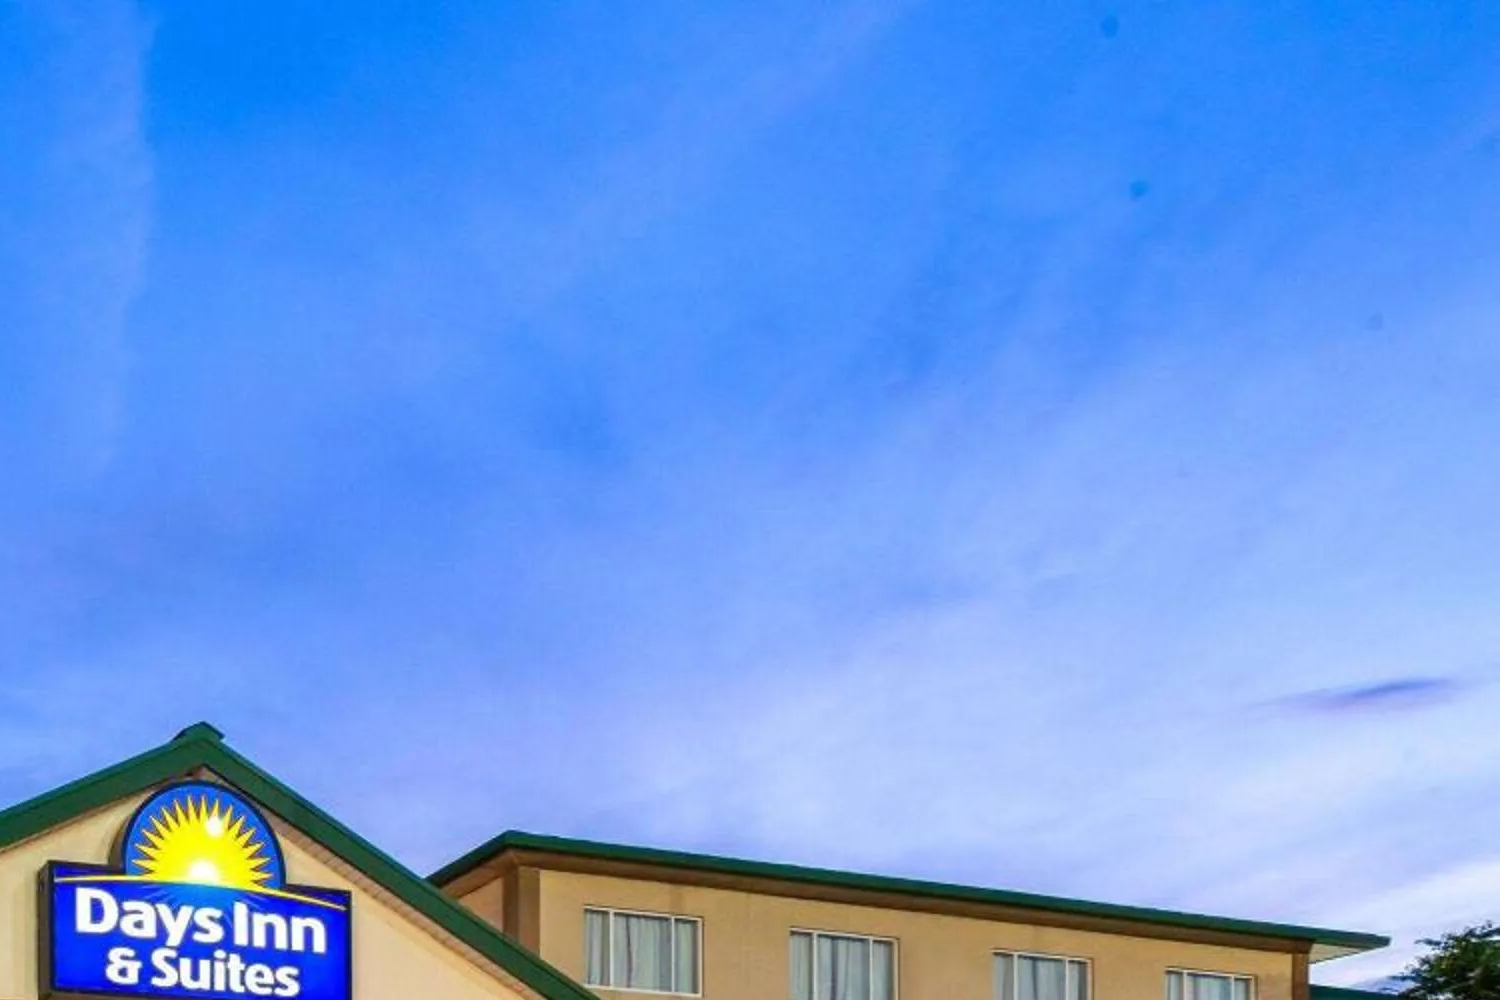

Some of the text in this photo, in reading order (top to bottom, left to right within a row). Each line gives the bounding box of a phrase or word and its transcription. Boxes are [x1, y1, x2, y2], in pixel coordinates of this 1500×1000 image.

[75, 887, 327, 953] Days Inn
[105, 947, 300, 997] & Suites
